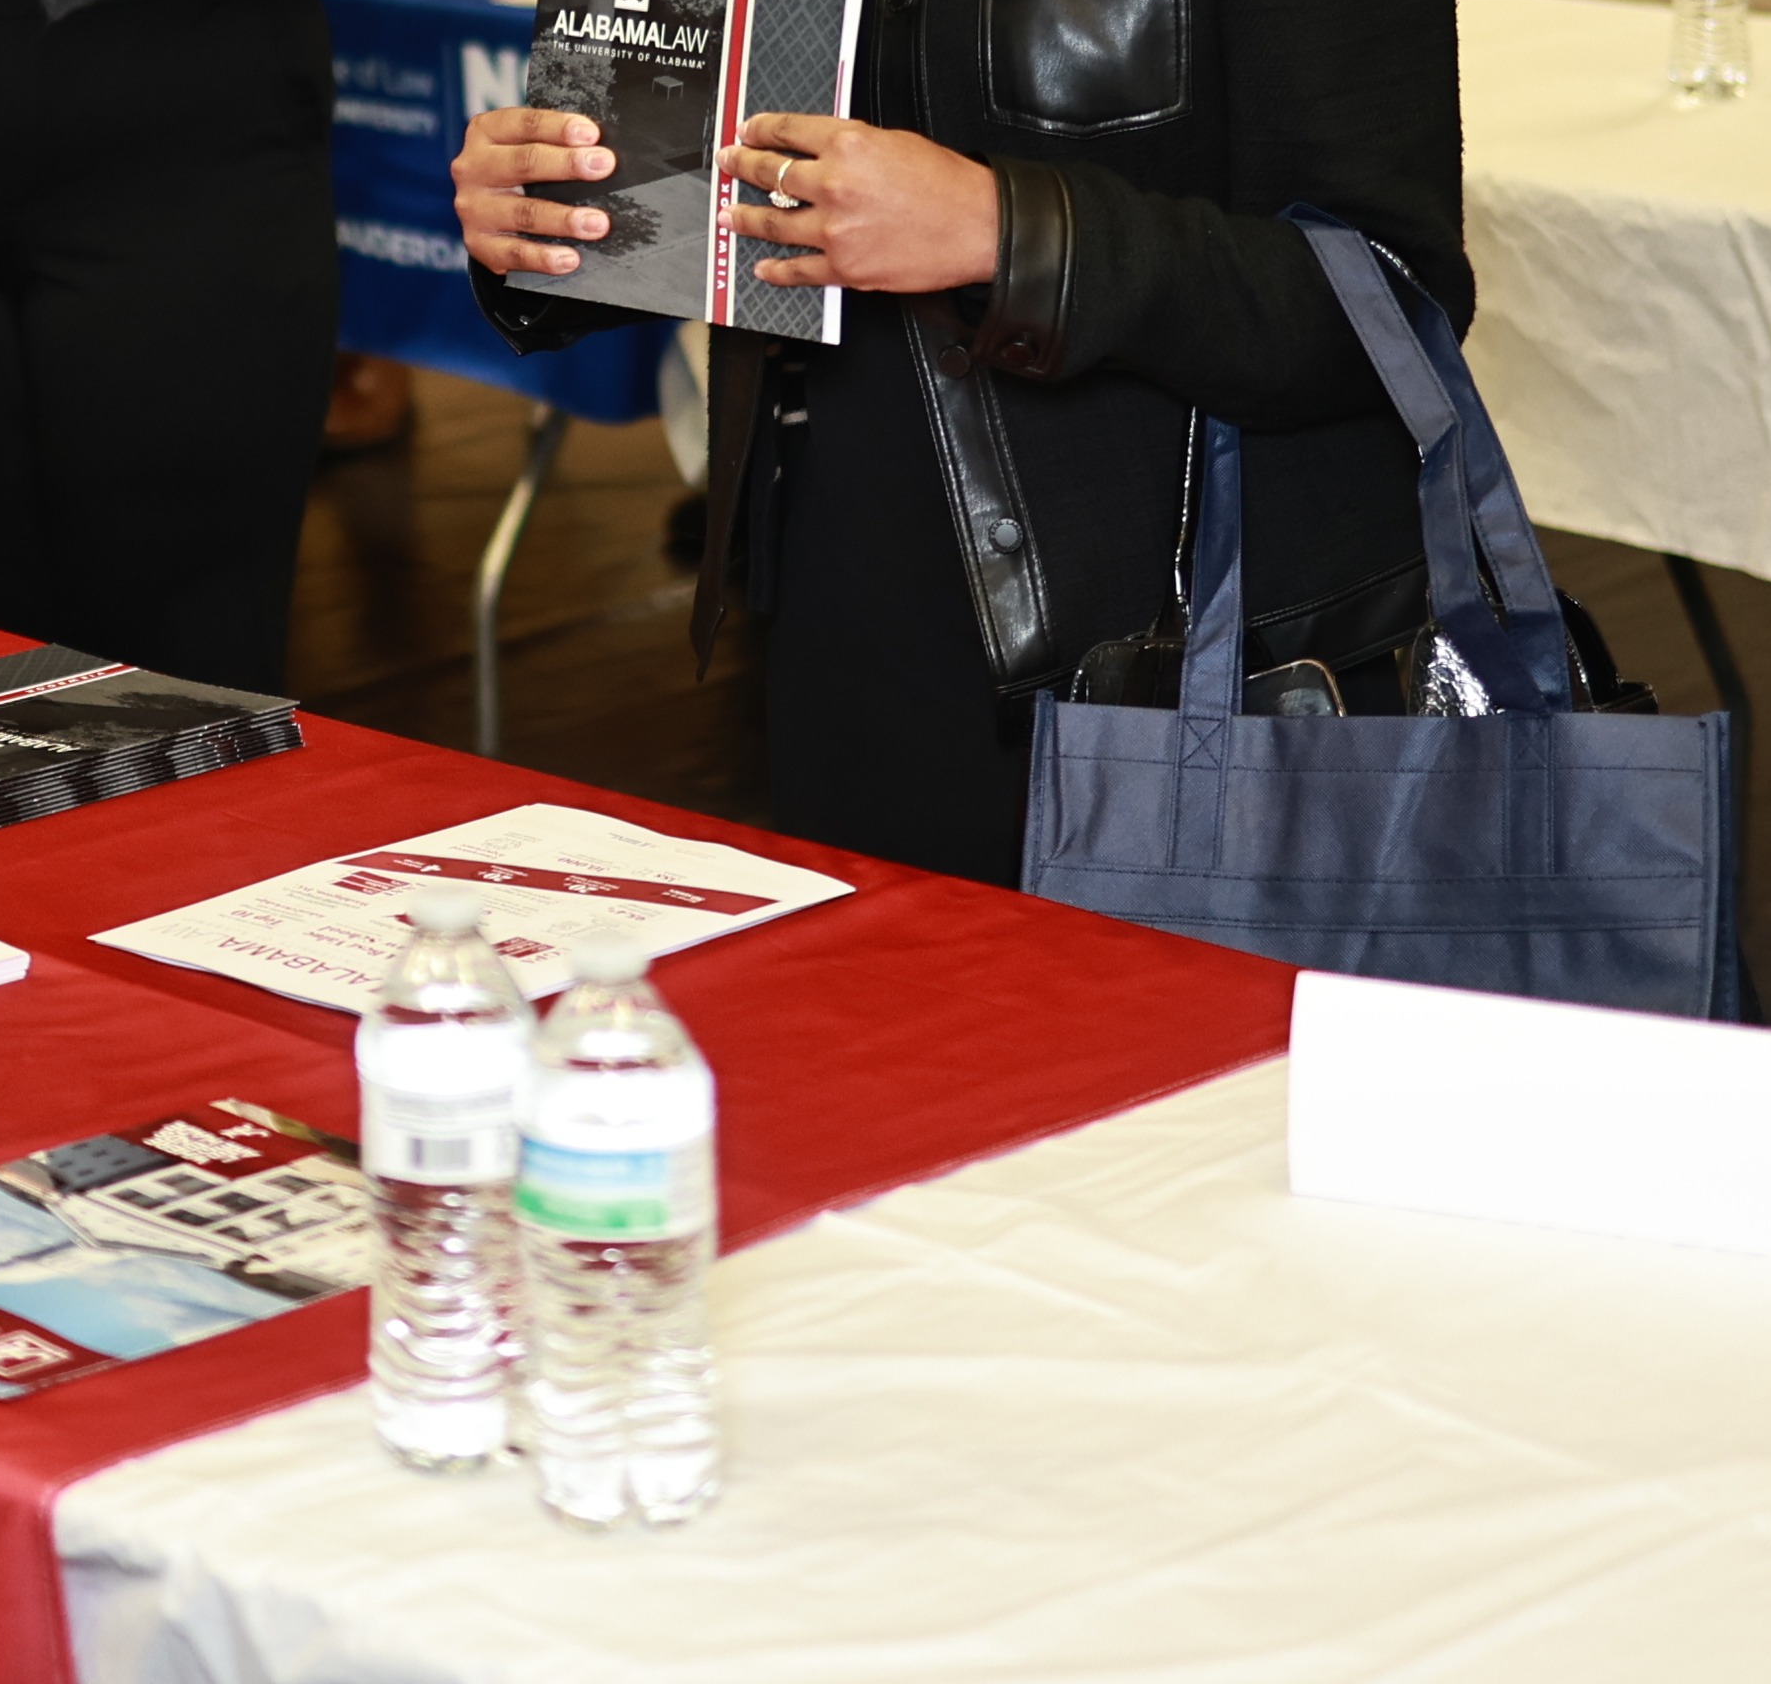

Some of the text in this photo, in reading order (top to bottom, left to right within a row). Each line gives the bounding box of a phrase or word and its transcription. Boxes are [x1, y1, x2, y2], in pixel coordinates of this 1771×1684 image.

[553, 9, 709, 54] ALABAMALAW
[553, 40, 570, 51] THE
[574, 43, 633, 60] UNIVERSITY
[637, 51, 650, 62] OF
[716, 183, 730, 290] VIEWBOK
